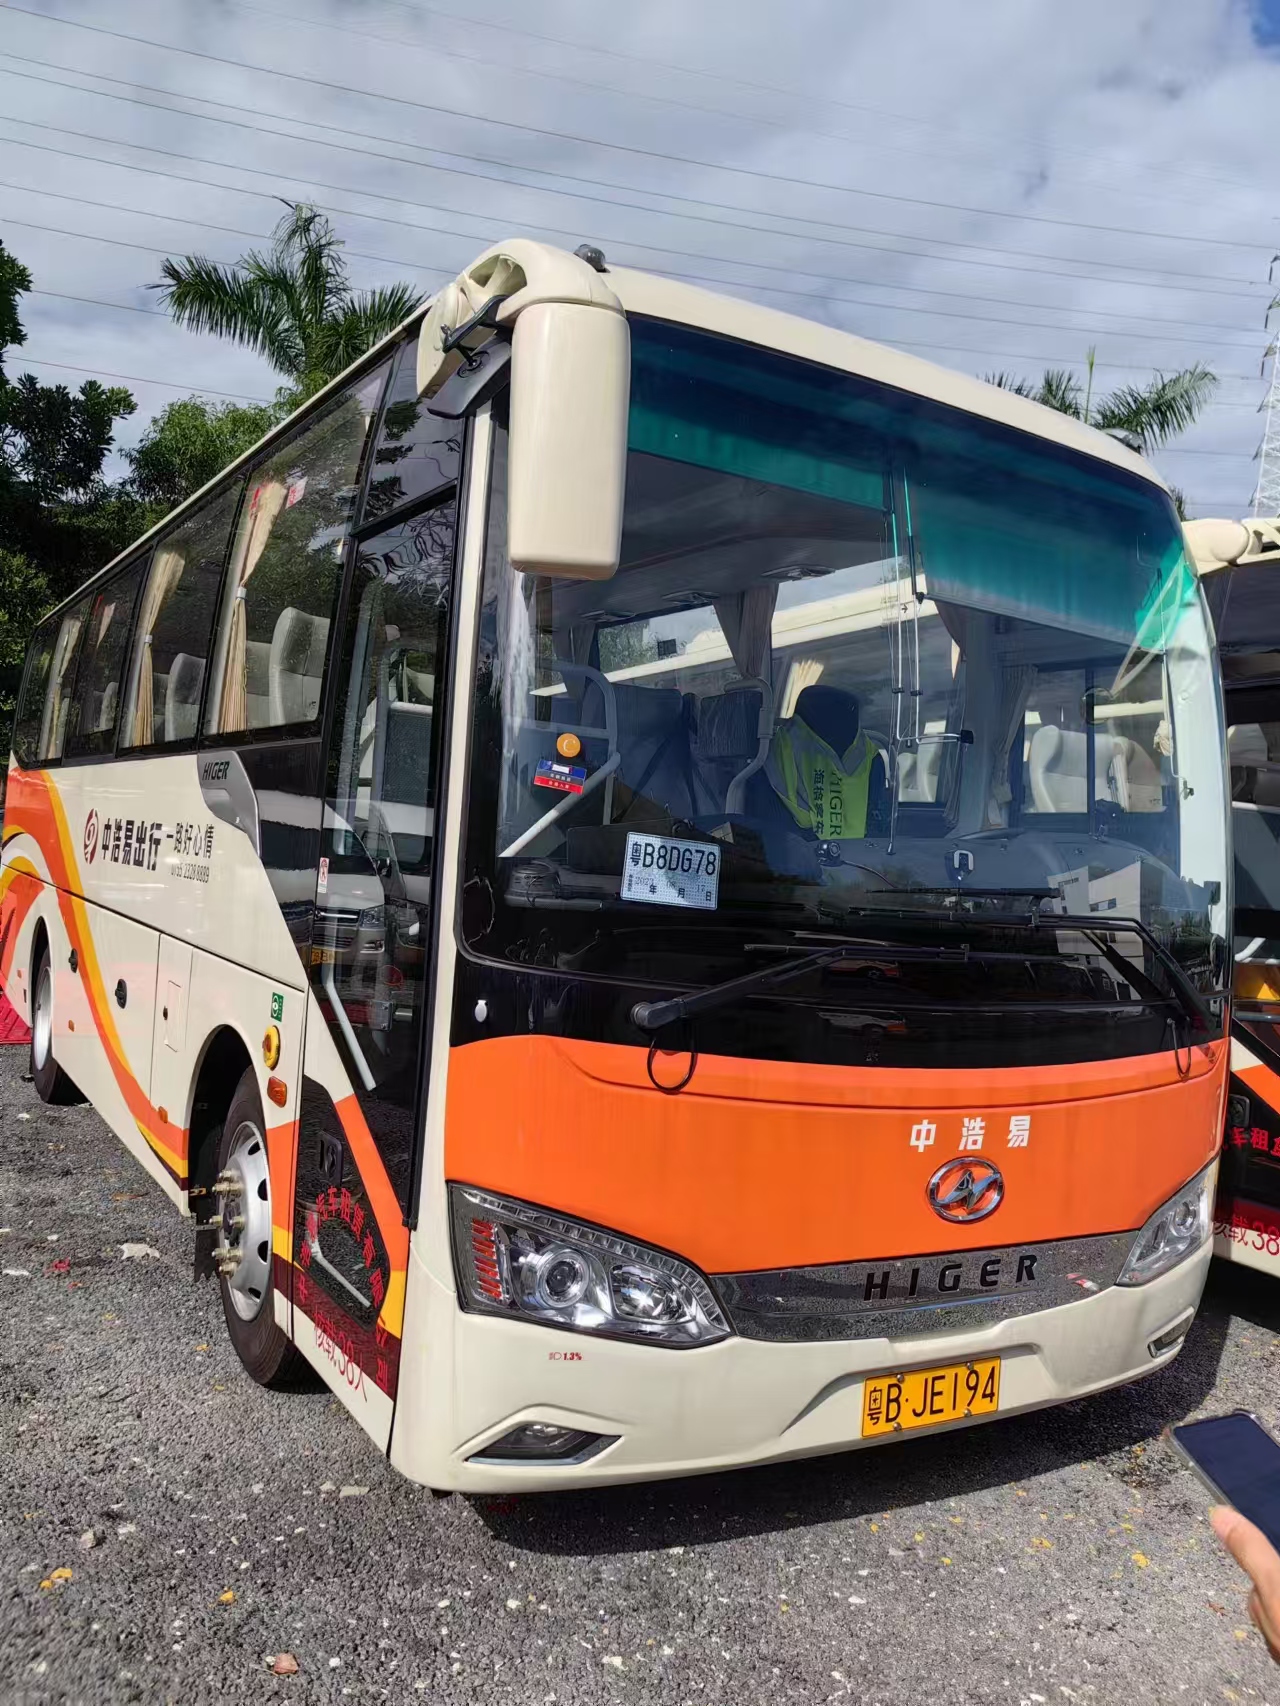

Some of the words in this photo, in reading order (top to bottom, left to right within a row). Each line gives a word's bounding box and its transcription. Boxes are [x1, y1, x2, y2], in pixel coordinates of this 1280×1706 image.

[202, 761, 230, 780] HIGER
[101, 818, 163, 871] 中浩易出行
[166, 822, 215, 859] 一路好心情
[630, 841, 717, 875] 粤B8DG78
[909, 1115, 1031, 1153] 中浩易
[1223, 1127, 1280, 1157] 车租
[864, 1254, 1038, 1301] HIGER
[563, 1352, 582, 1361] 1.3%
[867, 1366, 995, 1426] 粤B·JE194
